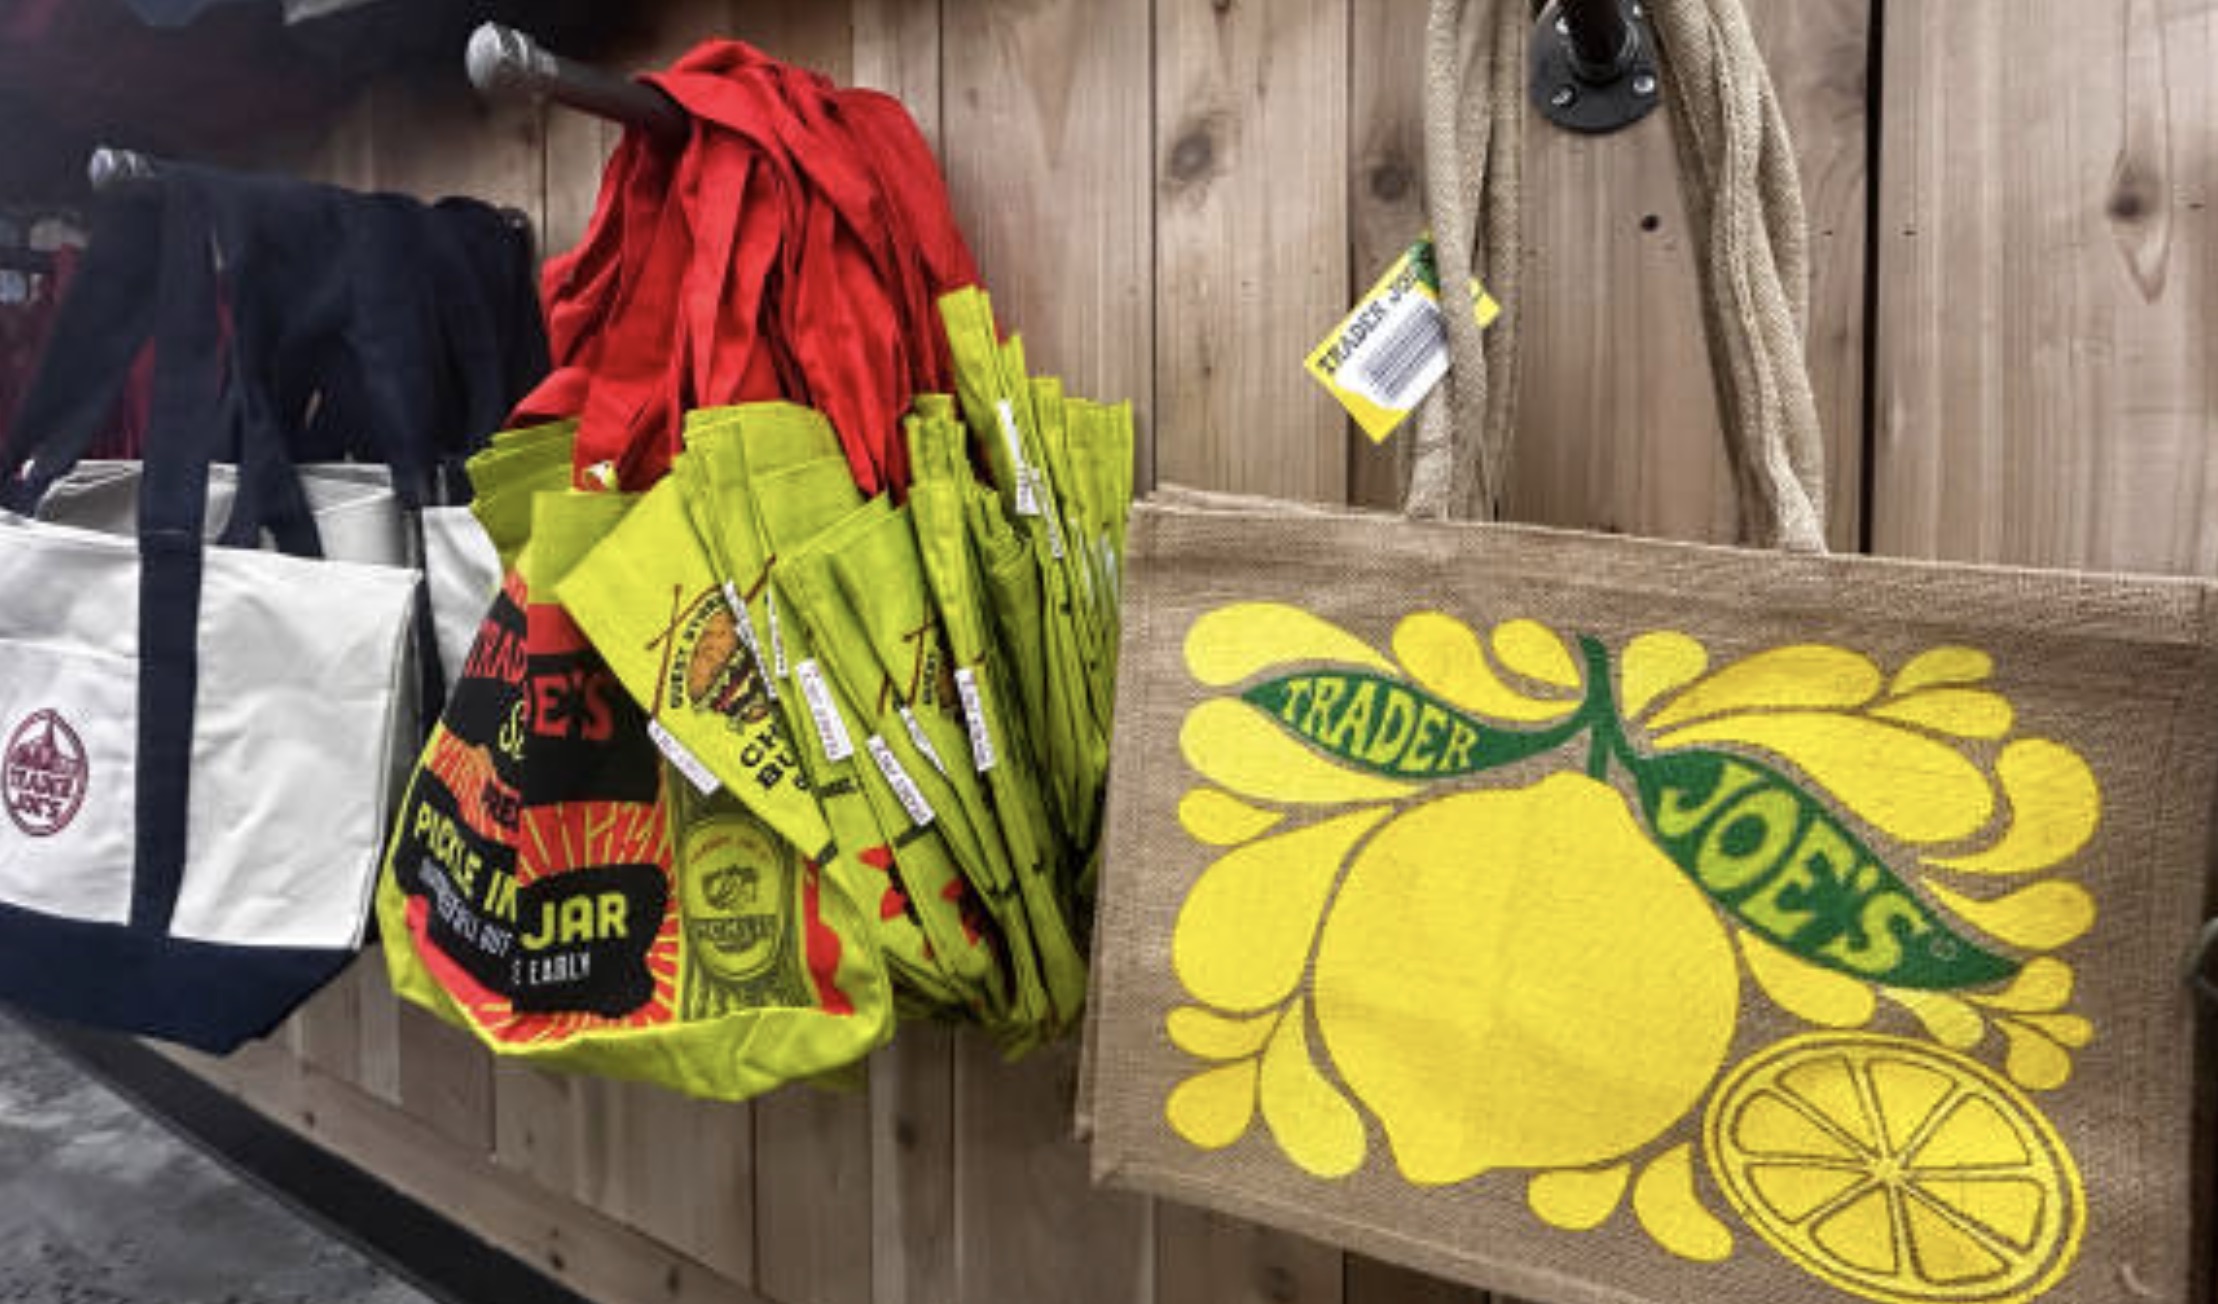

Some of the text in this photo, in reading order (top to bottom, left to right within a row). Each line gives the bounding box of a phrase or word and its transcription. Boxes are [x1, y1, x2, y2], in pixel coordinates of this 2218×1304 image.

[1315, 299, 1387, 374] TRADER
[464, 618, 529, 685] TRAD
[1283, 676, 1931, 975] TRADER JOE'S
[413, 801, 483, 899] PICKLE
[520, 892, 629, 950] JAR
[529, 952, 591, 986] EARLY
